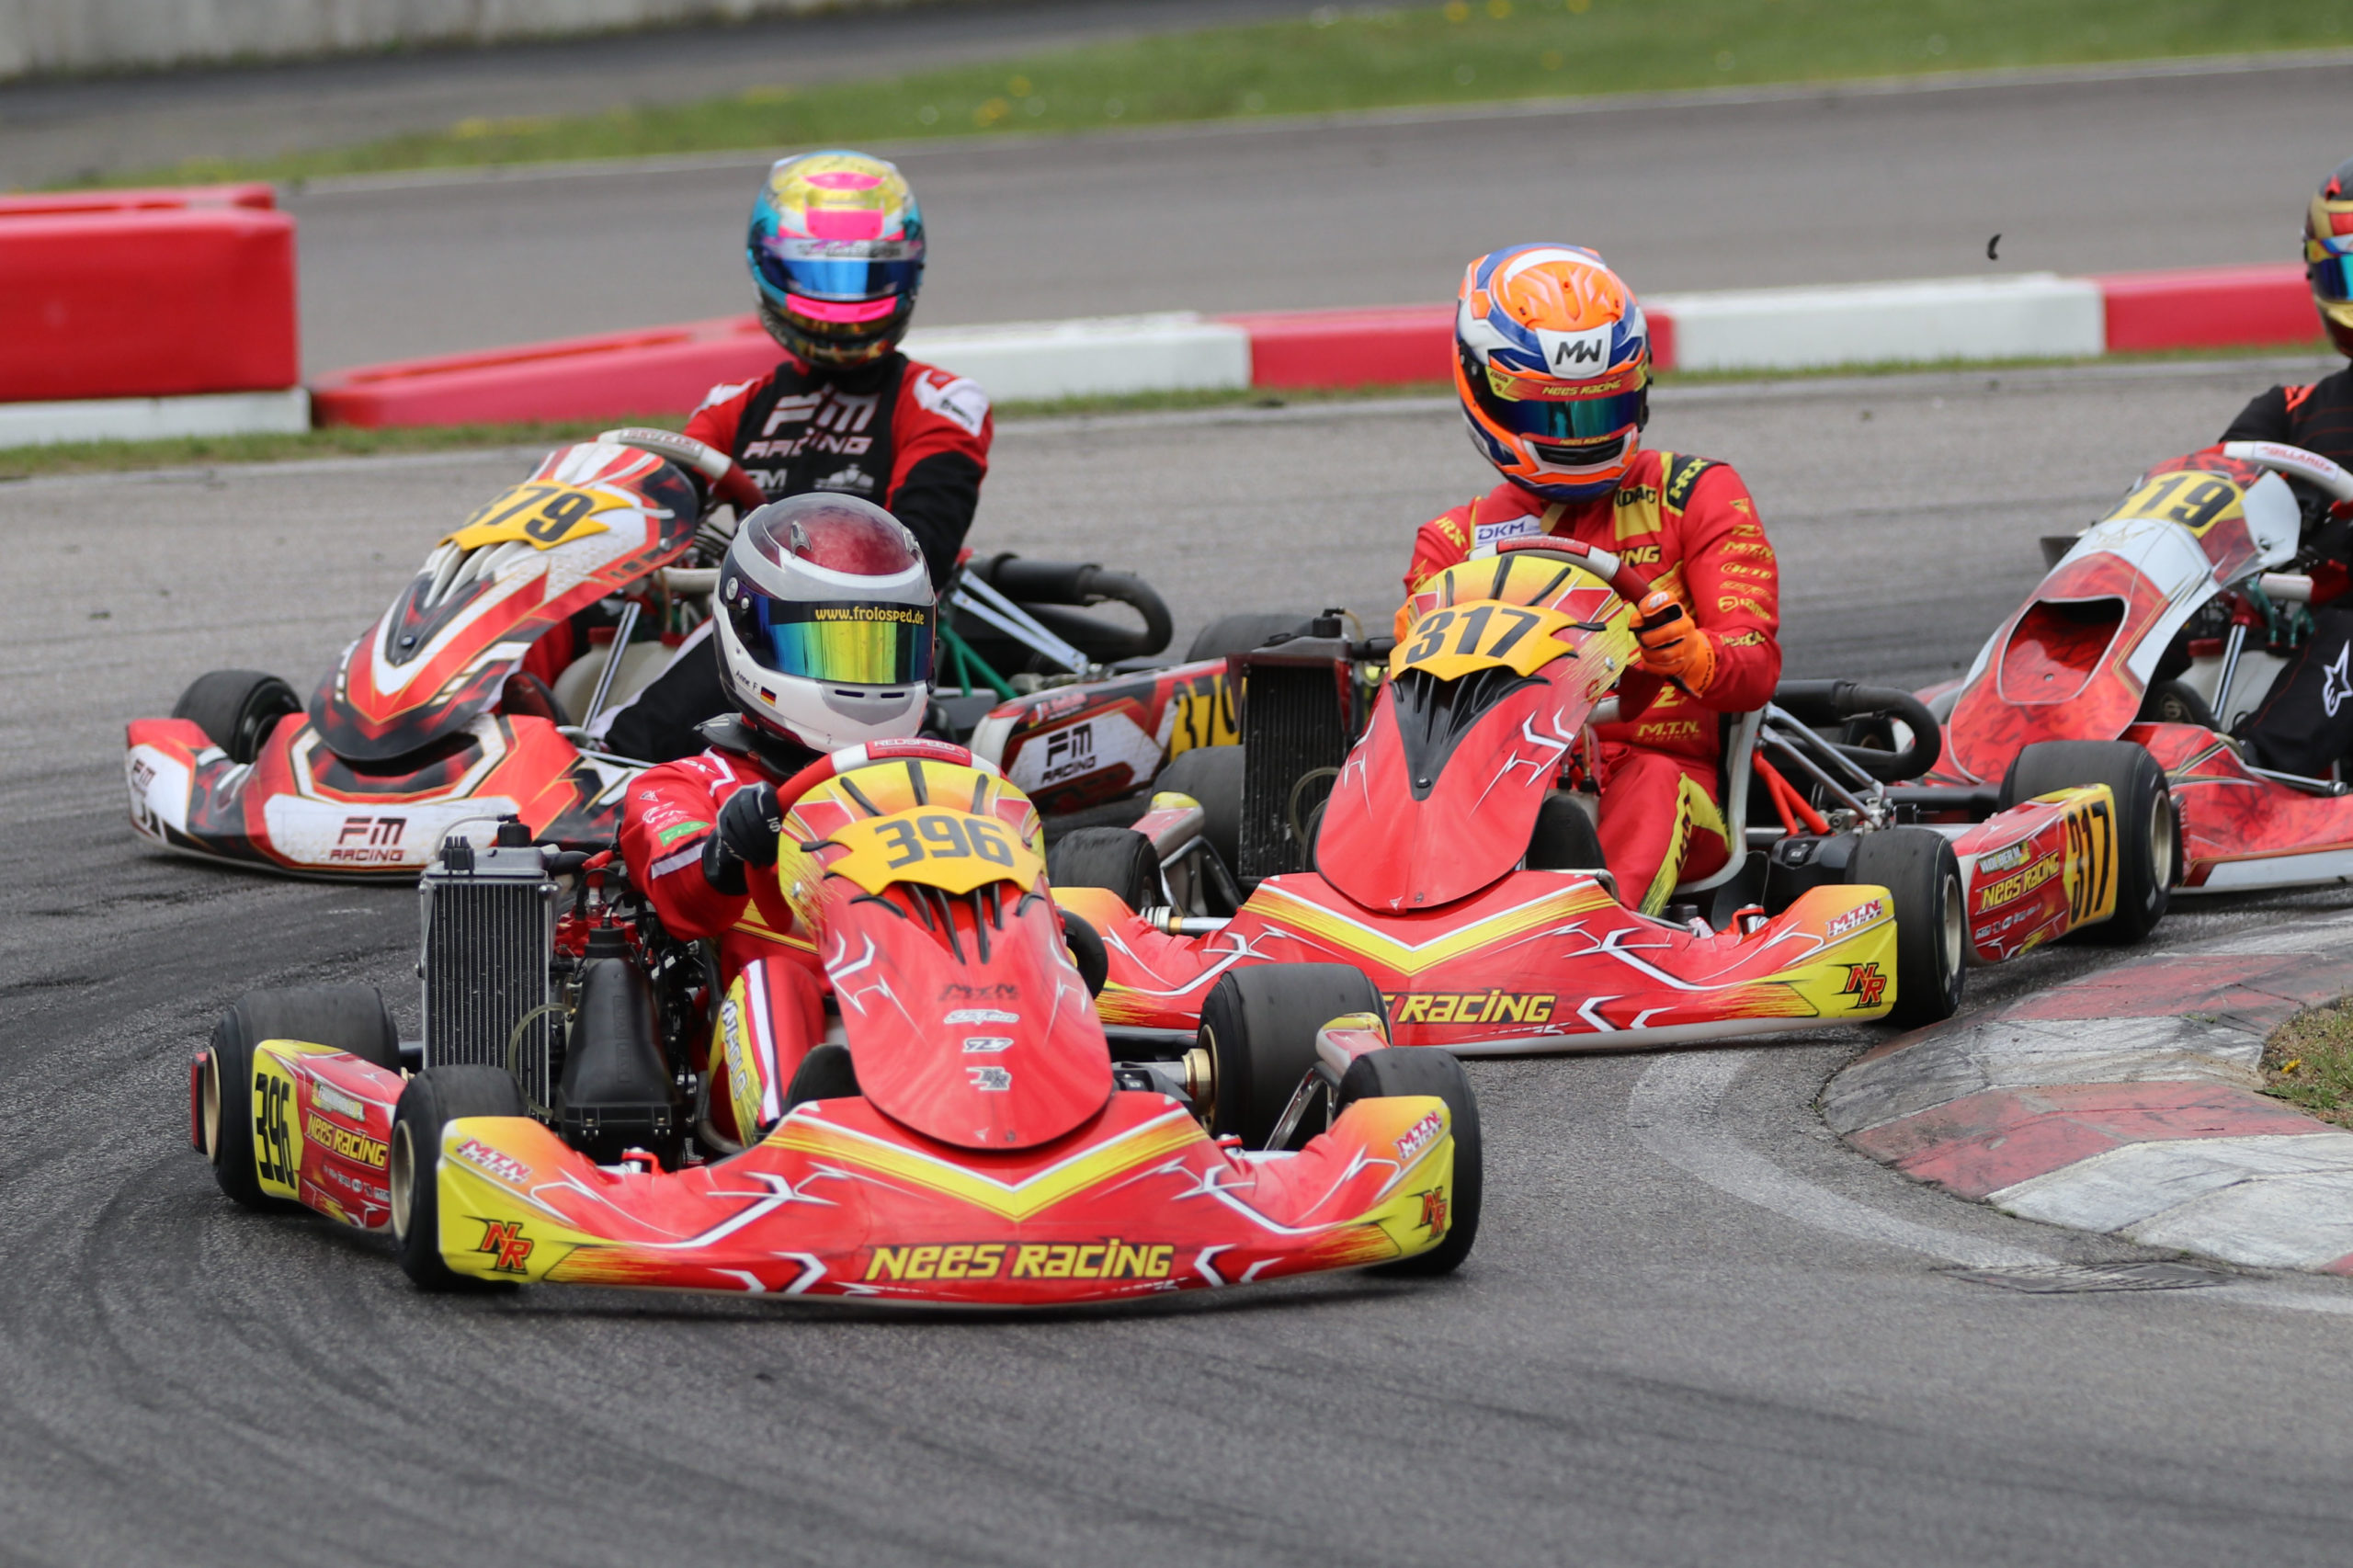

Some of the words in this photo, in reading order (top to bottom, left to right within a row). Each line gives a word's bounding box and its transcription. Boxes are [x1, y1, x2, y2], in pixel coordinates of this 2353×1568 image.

[1555, 339, 1603, 365] MW
[2103, 475, 2236, 528] 19
[1477, 520, 1526, 540] DKM
[815, 607, 925, 626] www.frolosped.de
[1404, 605, 1542, 665] 317
[873, 739, 956, 751] REDSPEED
[1040, 755, 1097, 784] RACING
[328, 848, 404, 861] RACING
[874, 814, 1015, 869] 396
[2068, 800, 2111, 925] 317
[255, 1072, 297, 1190] 396
